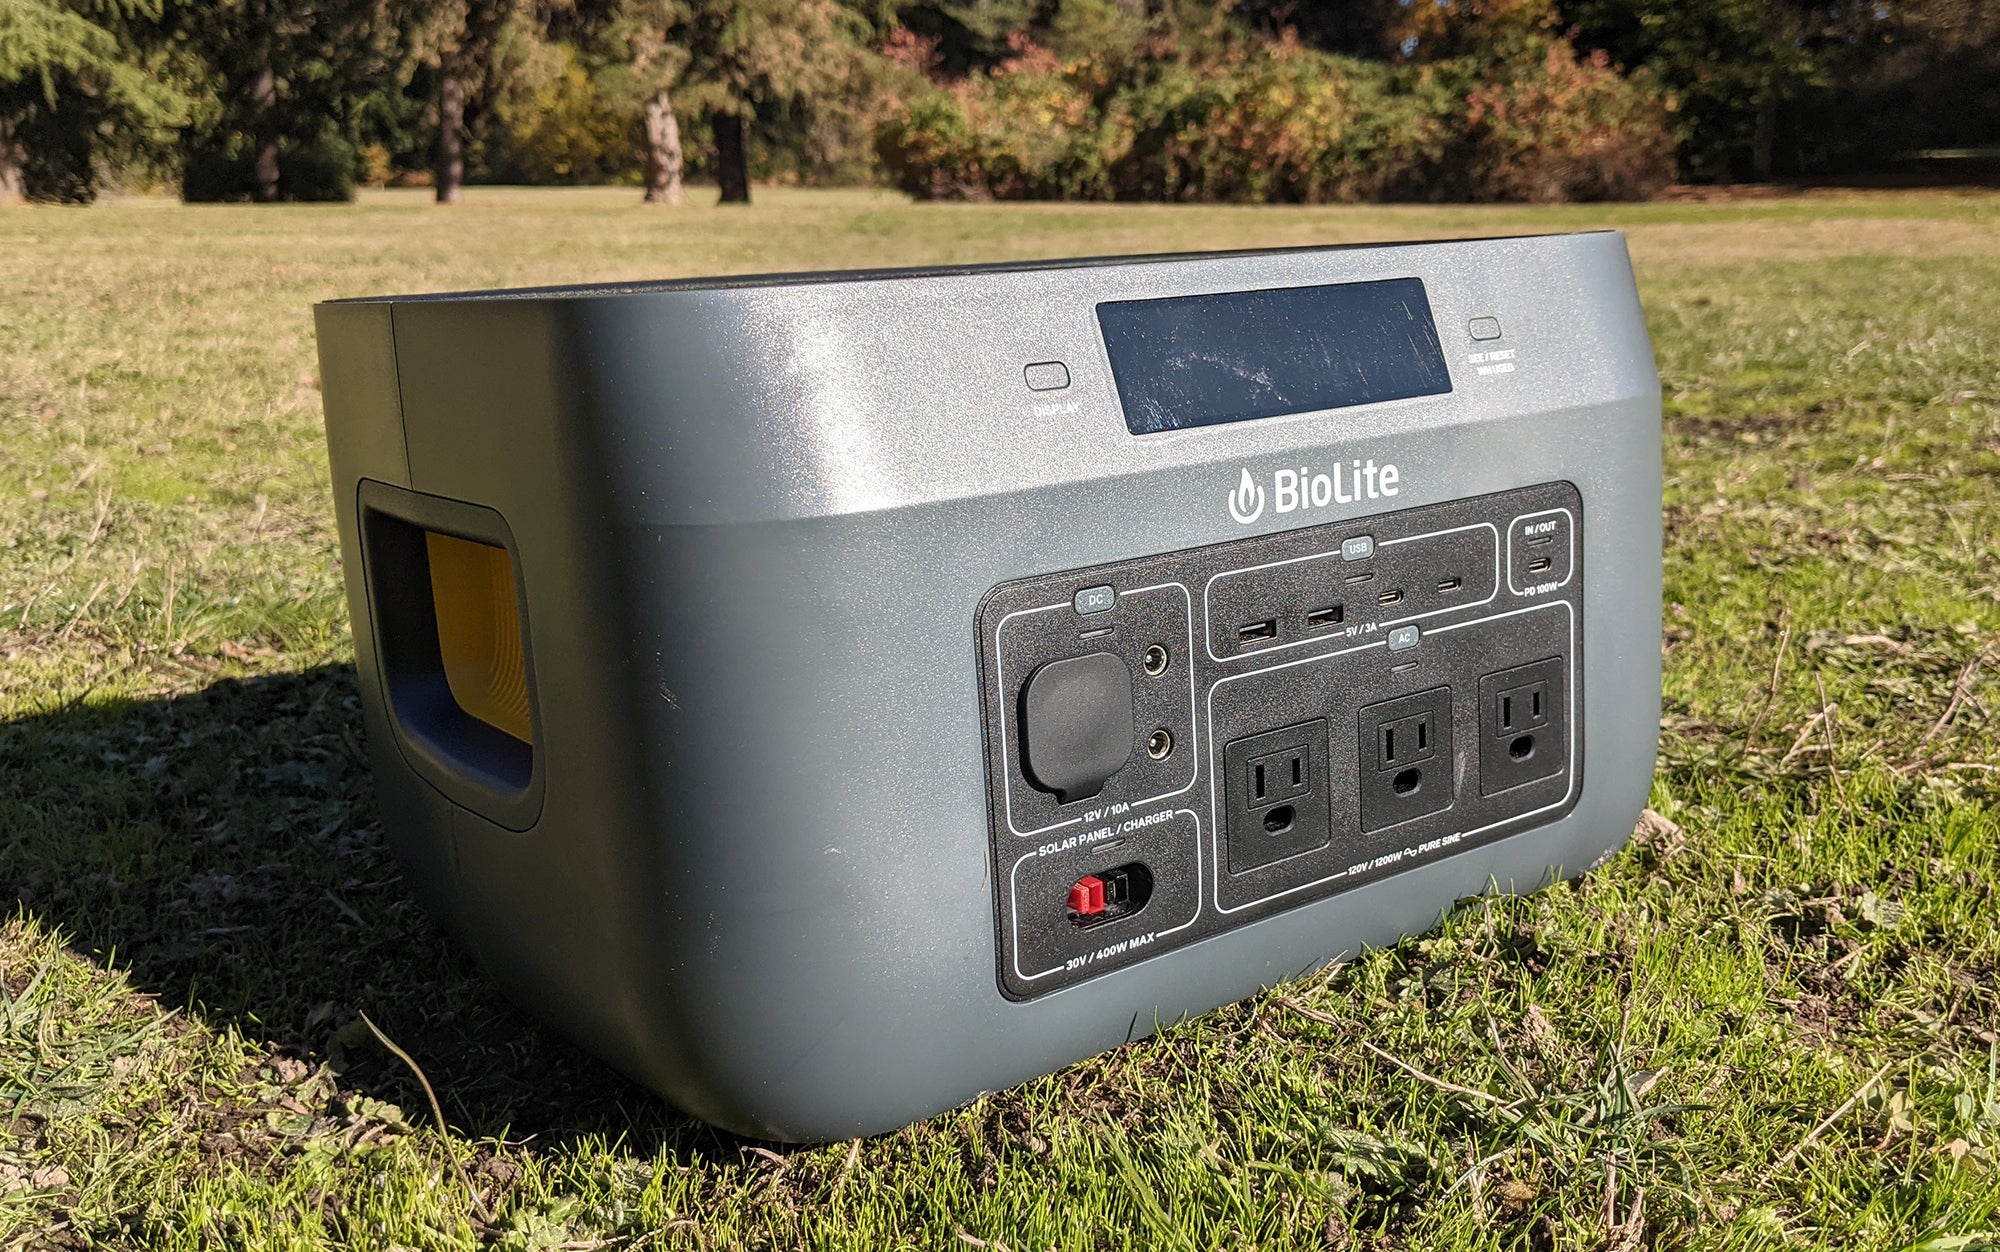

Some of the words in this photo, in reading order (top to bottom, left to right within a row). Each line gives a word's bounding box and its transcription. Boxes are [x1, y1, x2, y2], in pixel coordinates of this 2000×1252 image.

[1468, 353, 1485, 363] SEE
[1490, 349, 1515, 361] RESET
[1034, 400, 1079, 416] DISPLAY
[1275, 459, 1399, 514] BioLite
[1349, 542, 1367, 555] USB
[1524, 586, 1535, 597] PD
[1537, 581, 1558, 594] 100W
[1089, 594, 1103, 605] DC
[1346, 625, 1358, 637] 5V
[1365, 621, 1377, 633] 3A
[1398, 633, 1410, 643] AC
[1084, 808, 1101, 822] 12V
[1111, 801, 1130, 816] 10A
[1039, 836, 1077, 857] SOLAR
[1079, 826, 1114, 845] PANEL
[1123, 809, 1174, 832] CHARGER
[1347, 861, 1368, 875] 120V
[1375, 850, 1402, 867] 1200W
[1418, 838, 1441, 853] PURE
[1441, 832, 1461, 846] SINE
[1066, 954, 1087, 971] 30V
[1096, 940, 1128, 960] 400W
[1129, 931, 1155, 949] MAX
